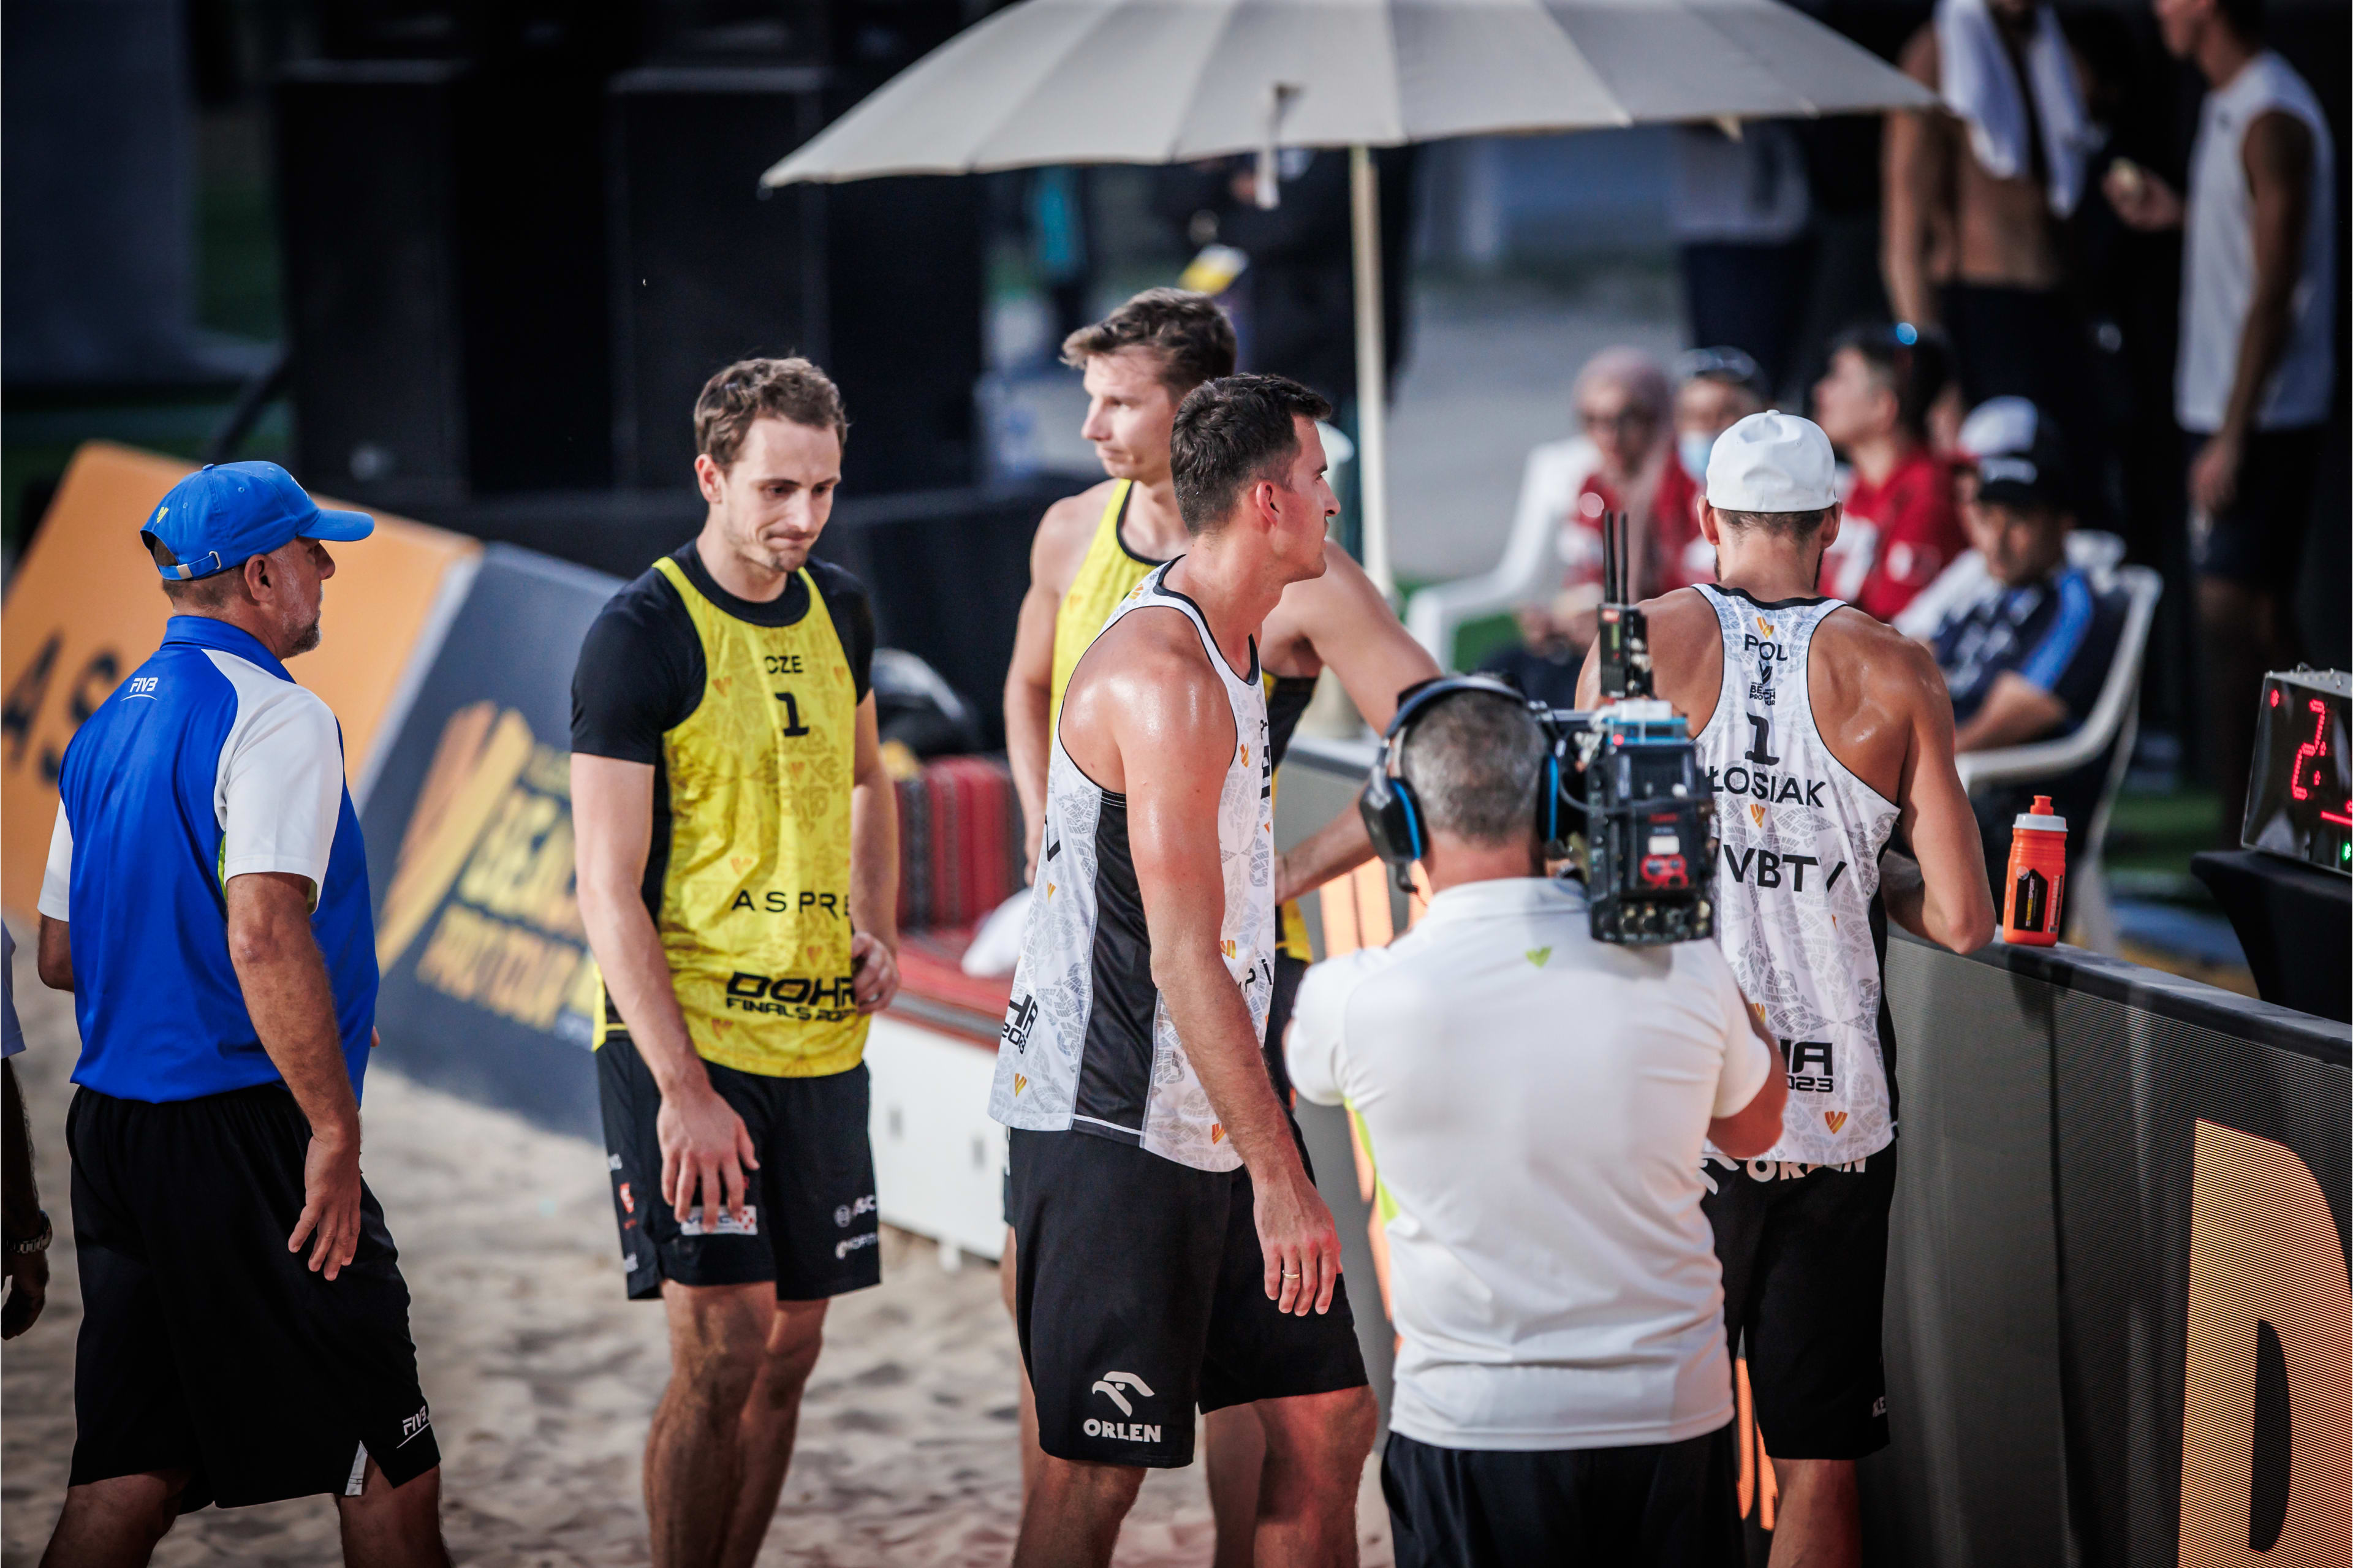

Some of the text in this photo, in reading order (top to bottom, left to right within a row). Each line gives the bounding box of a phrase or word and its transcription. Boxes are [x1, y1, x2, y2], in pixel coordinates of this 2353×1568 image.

[1744, 633, 1788, 661] POL
[765, 656, 803, 674] CZE
[129, 676, 159, 693] FIVB
[775, 692, 809, 737] 1
[1745, 712, 1779, 766] 1
[1707, 766, 1826, 808] ŁOSIAK
[727, 998, 811, 1021] FINALS
[1083, 1418, 1161, 1443] ORLEN
